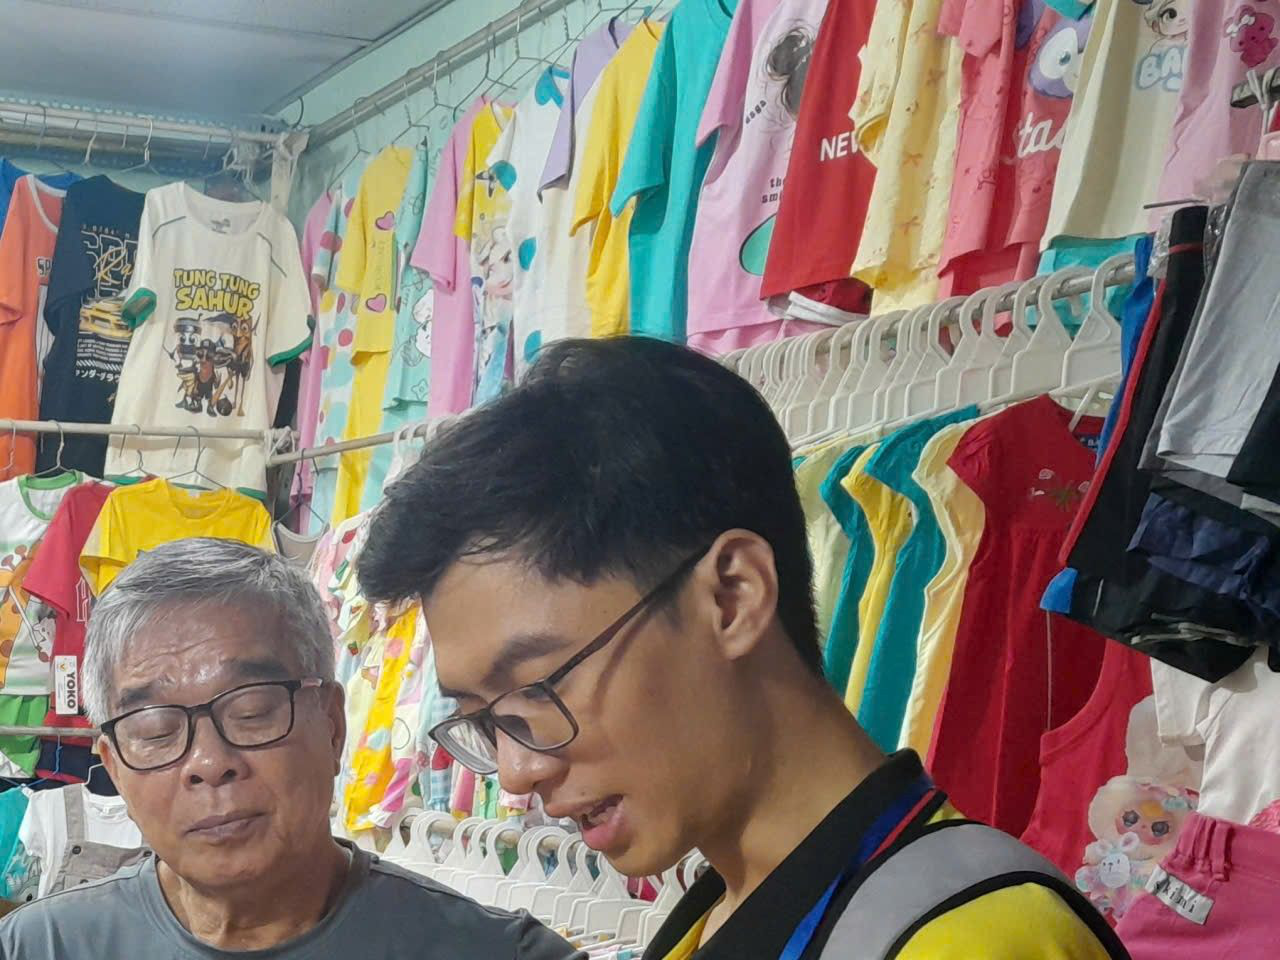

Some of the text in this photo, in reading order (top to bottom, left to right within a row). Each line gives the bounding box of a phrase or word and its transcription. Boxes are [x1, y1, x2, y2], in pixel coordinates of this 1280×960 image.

[173, 268, 260, 300] TUNG TUNG
[175, 287, 254, 318] SAHUR
[64, 671, 76, 710] YOKO
